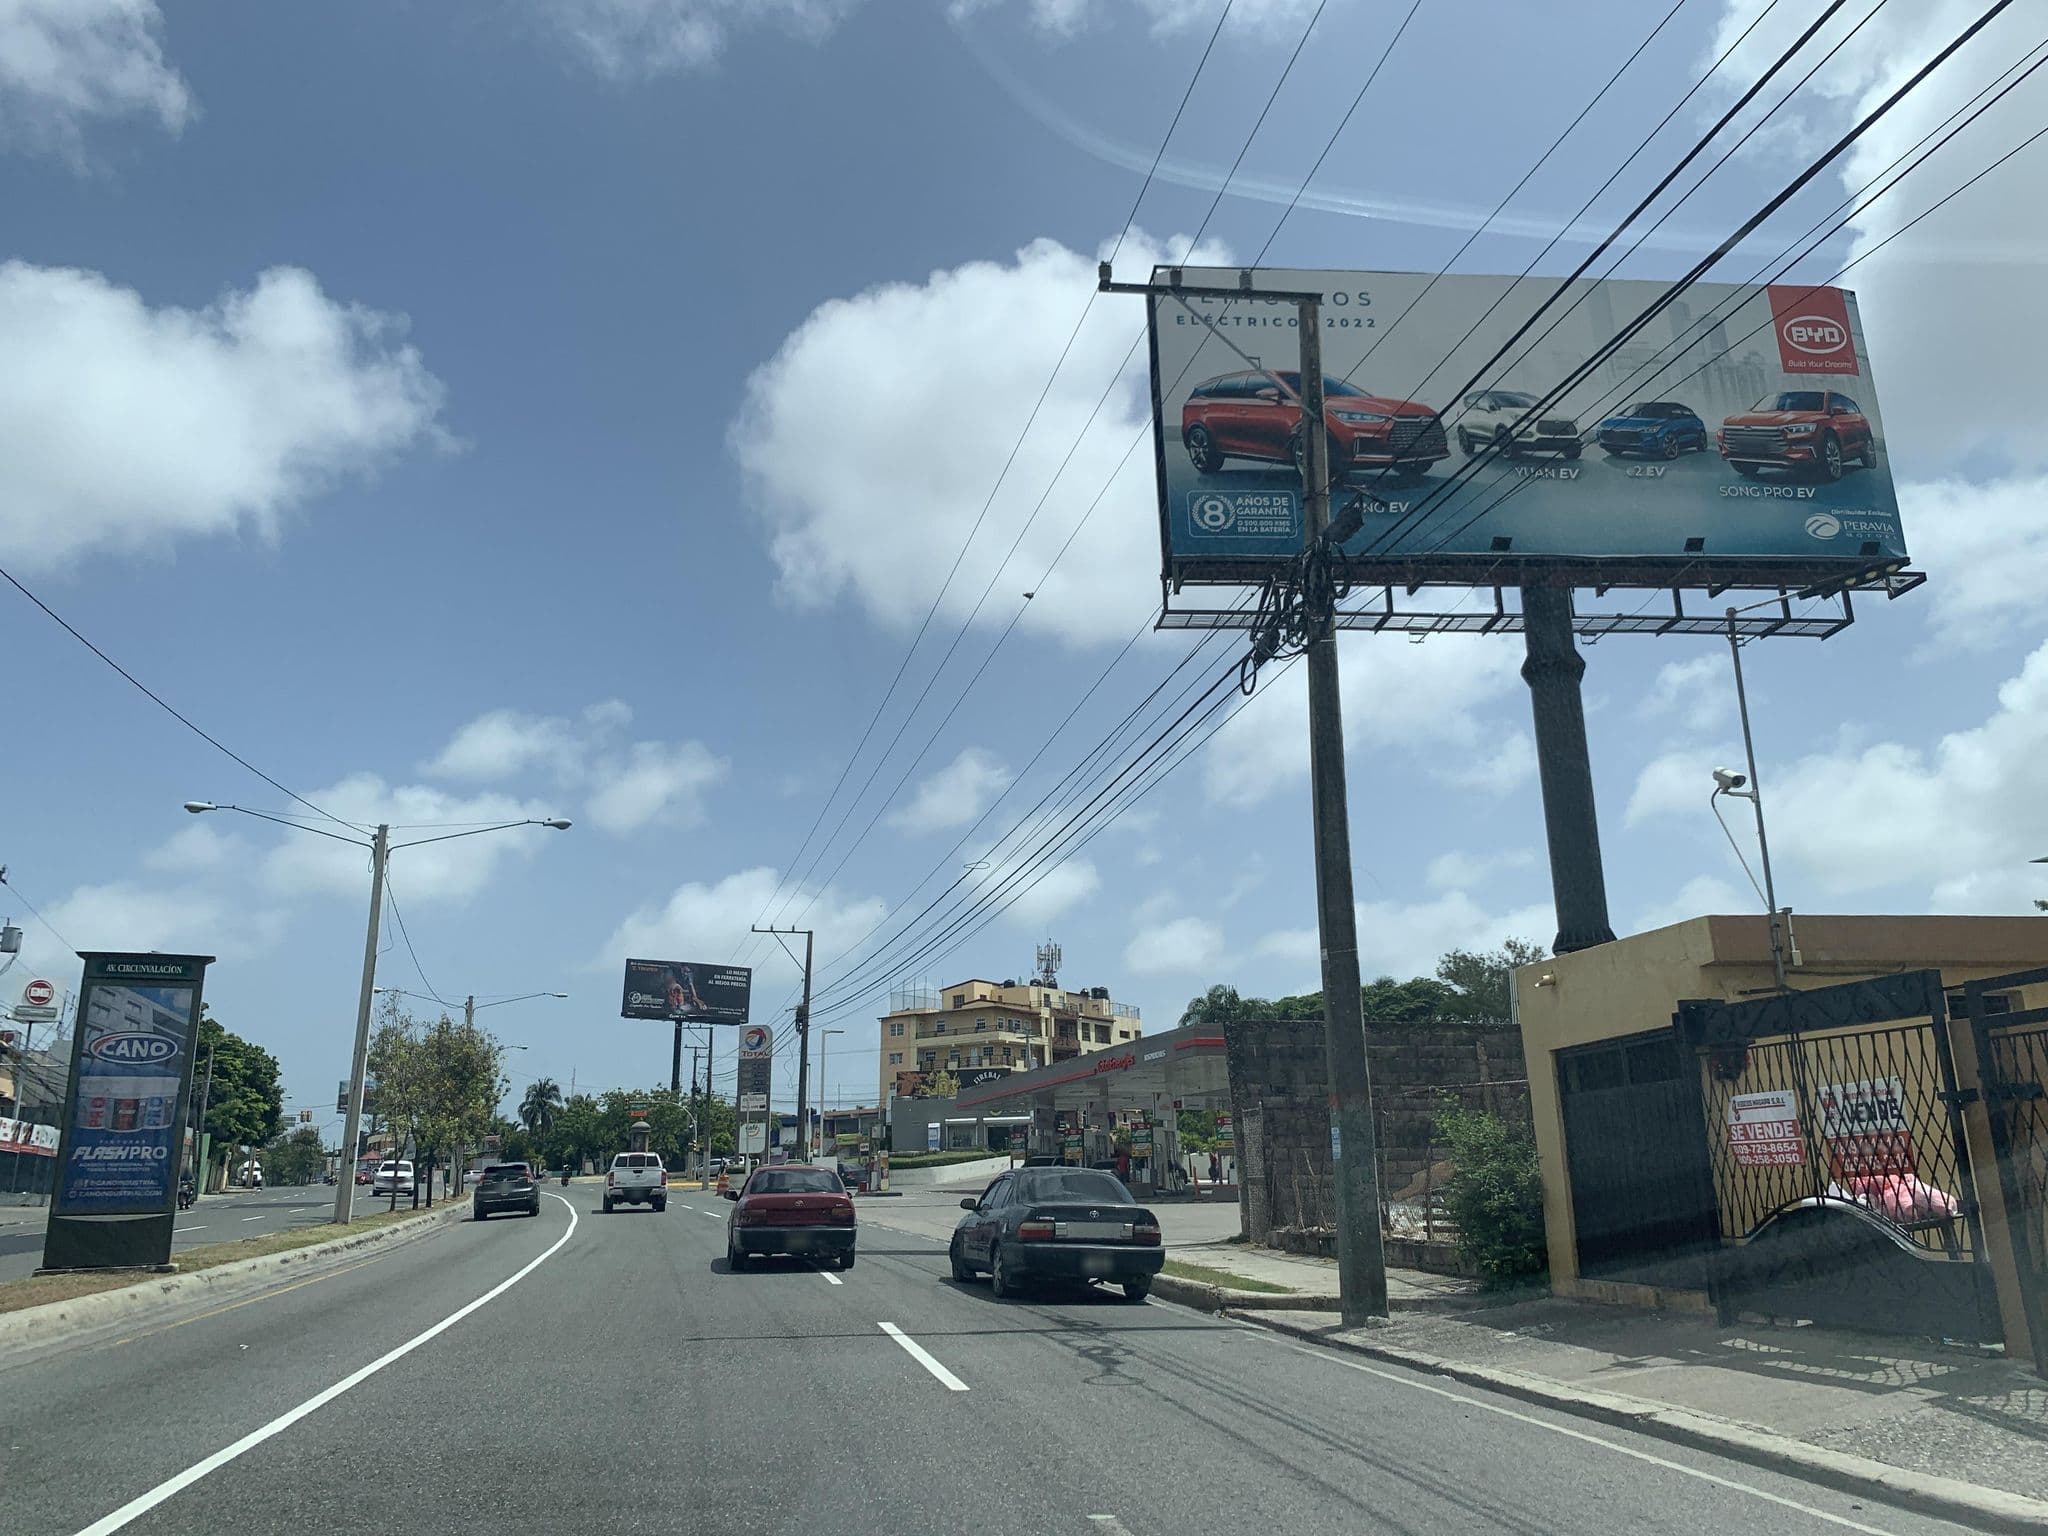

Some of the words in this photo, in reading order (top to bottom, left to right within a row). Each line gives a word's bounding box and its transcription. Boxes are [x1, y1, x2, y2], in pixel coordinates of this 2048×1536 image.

[1176, 314, 1299, 328] ELÉCTRICO
[1326, 317, 1376, 328] 2022
[1791, 326, 1840, 343] BYD
[1808, 360, 1824, 368] Your
[1825, 360, 1852, 368] Dreams
[1560, 468, 1579, 479] EV
[1646, 467, 1665, 477] EV
[1719, 486, 1760, 498] SONG
[1764, 487, 1793, 498] PRO
[1797, 488, 1816, 498] EV
[1236, 495, 1270, 506] AÑOS
[1273, 497, 1289, 506] DE
[1204, 500, 1226, 526] 8
[1237, 506, 1289, 516] GARANTÍA
[1344, 502, 1384, 513] NG
[1389, 502, 1410, 513] EV
[1844, 521, 1895, 533] PERAVIA
[102, 1040, 169, 1058] CANO
[1731, 1125, 1745, 1141] SE
[1746, 1121, 1795, 1140] VENDE
[1733, 1142, 1798, 1155] 809-729-8654
